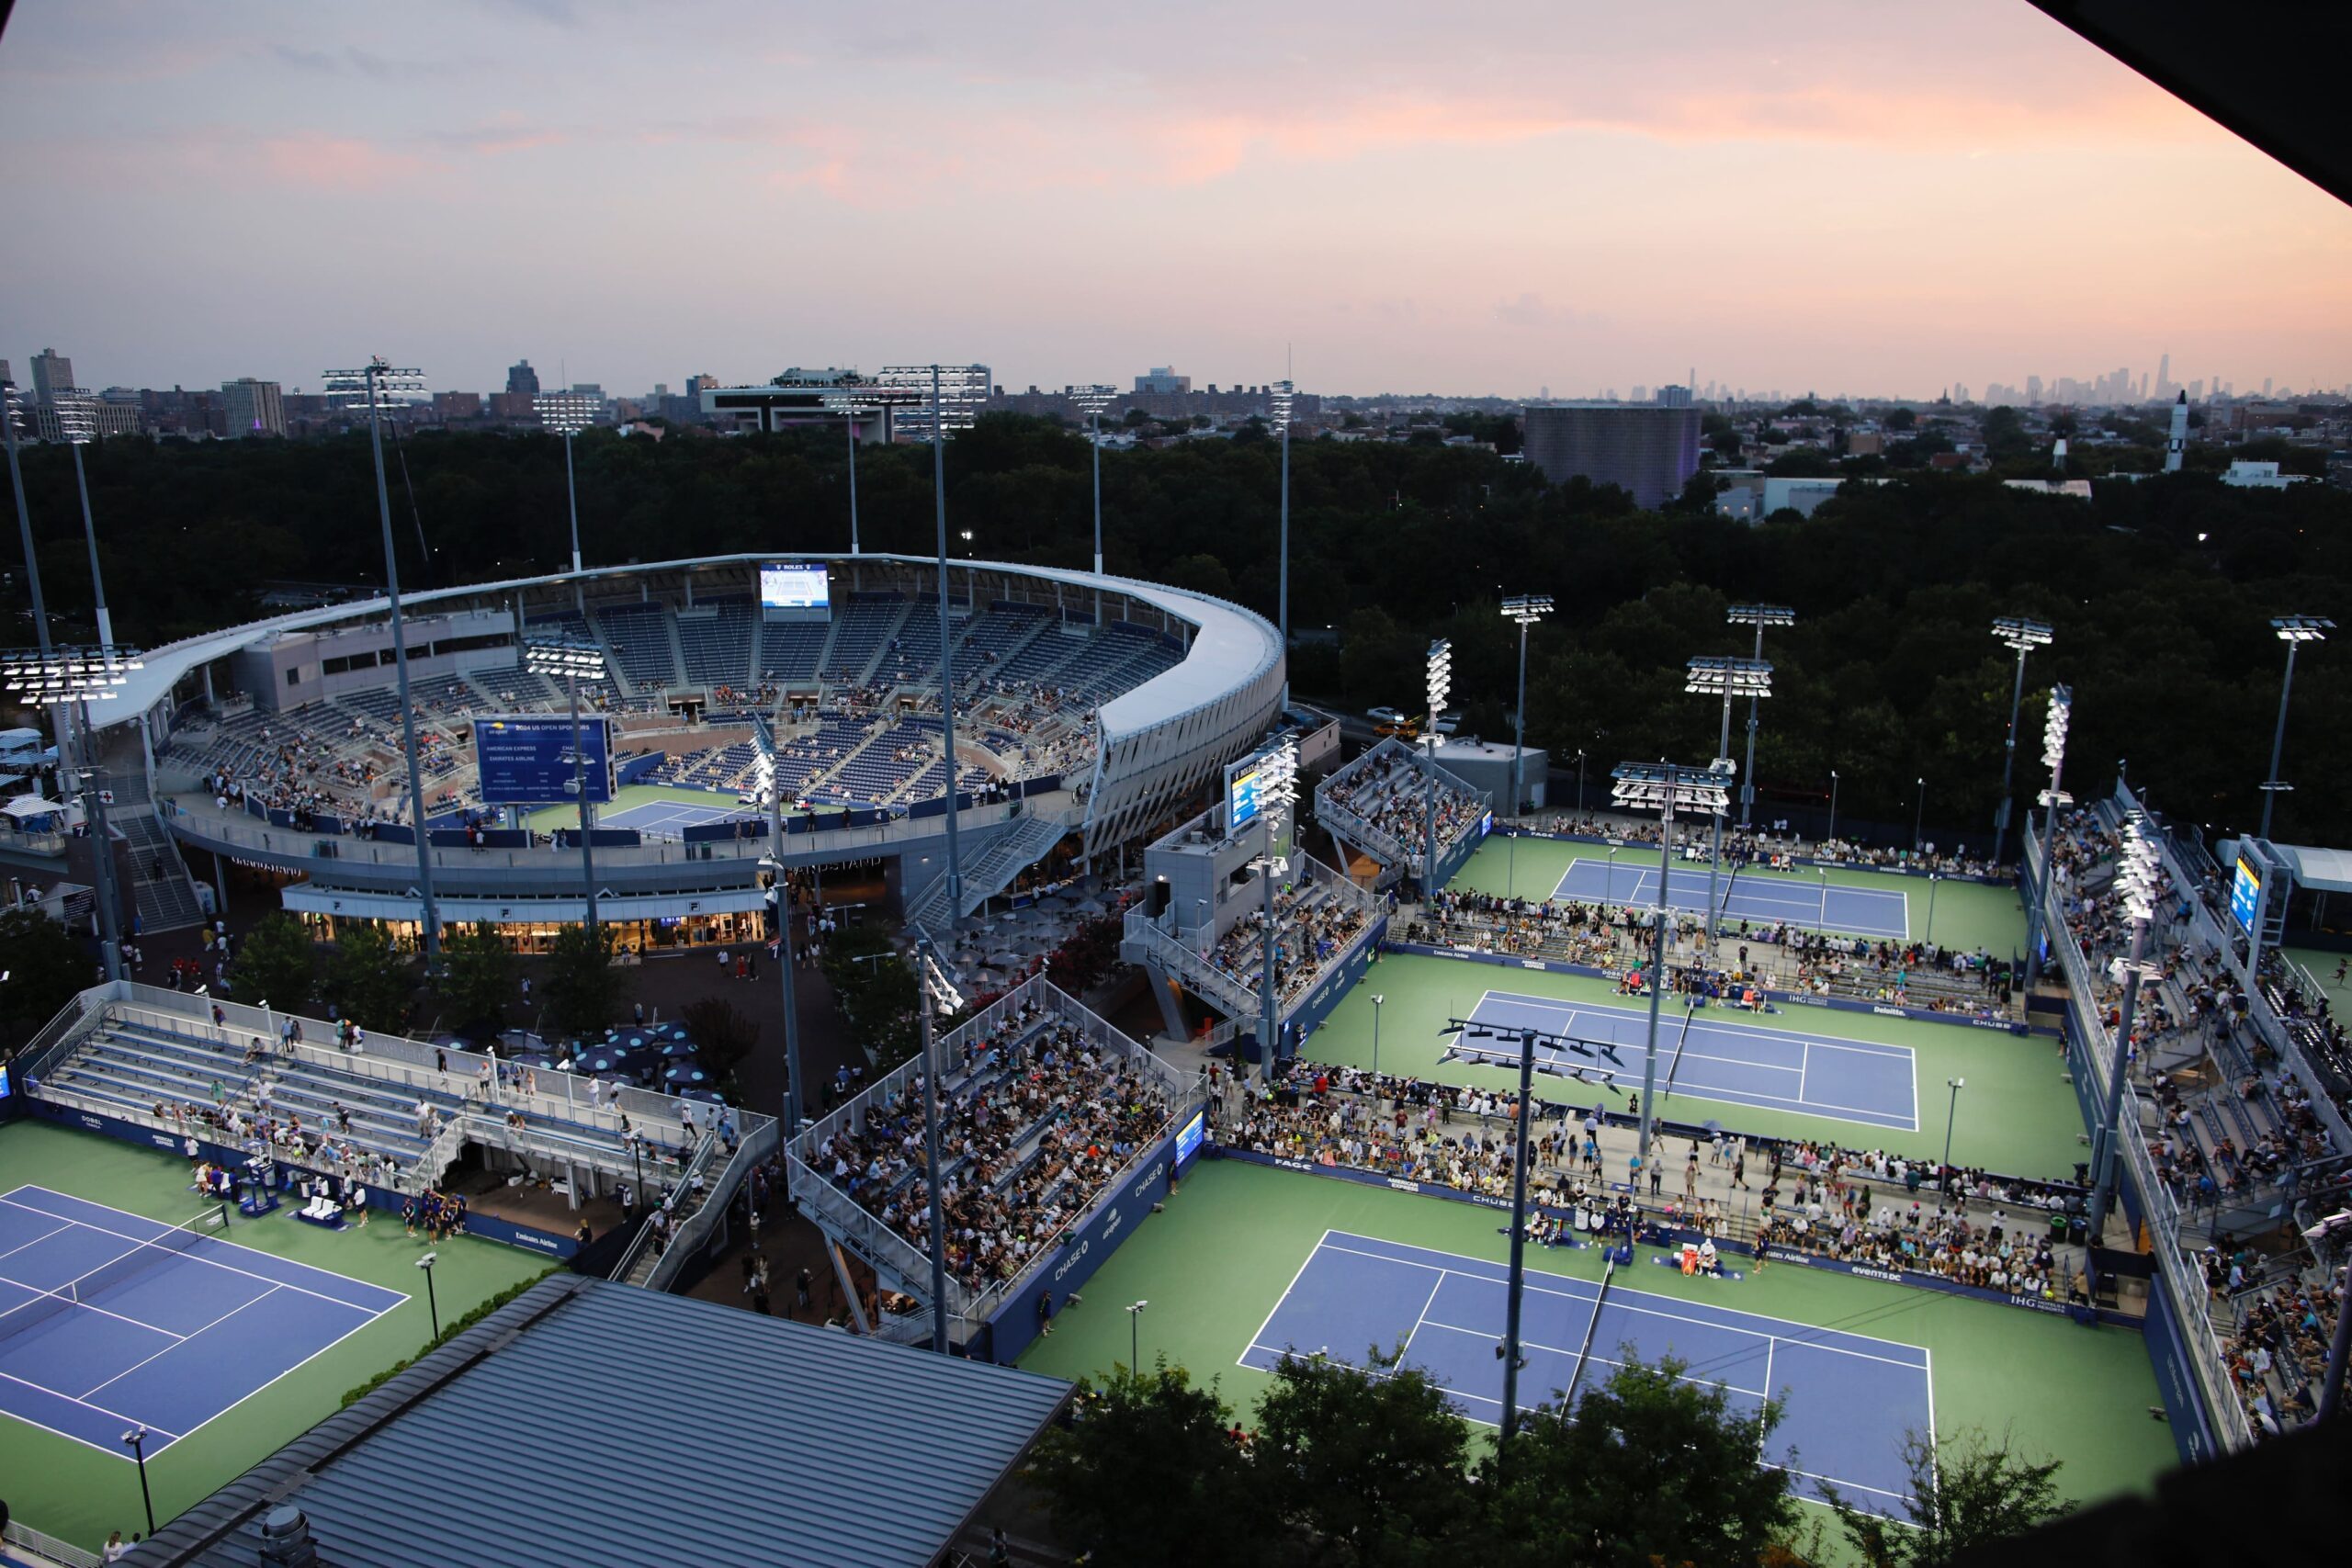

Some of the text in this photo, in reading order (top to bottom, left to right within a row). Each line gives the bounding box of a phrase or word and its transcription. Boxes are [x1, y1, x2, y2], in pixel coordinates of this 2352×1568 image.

[1789, 995, 1806, 1003] IHG
[1973, 1019, 2010, 1029] CHUBB
[81, 1115, 103, 1125] DOBEL
[152, 1134, 174, 1143] AMERICAN
[1135, 1169, 1159, 1197] CHASE
[1387, 1178, 1419, 1188] AMERICAN
[1391, 1182, 1419, 1192] EXPRESS
[515, 1232, 558, 1248] Emirates Airline
[1055, 1247, 1081, 1280] CHASE
[1784, 1253, 1810, 1264] Airline
[1888, 1273, 1902, 1281] DC
[2010, 1295, 2036, 1307] IHG
